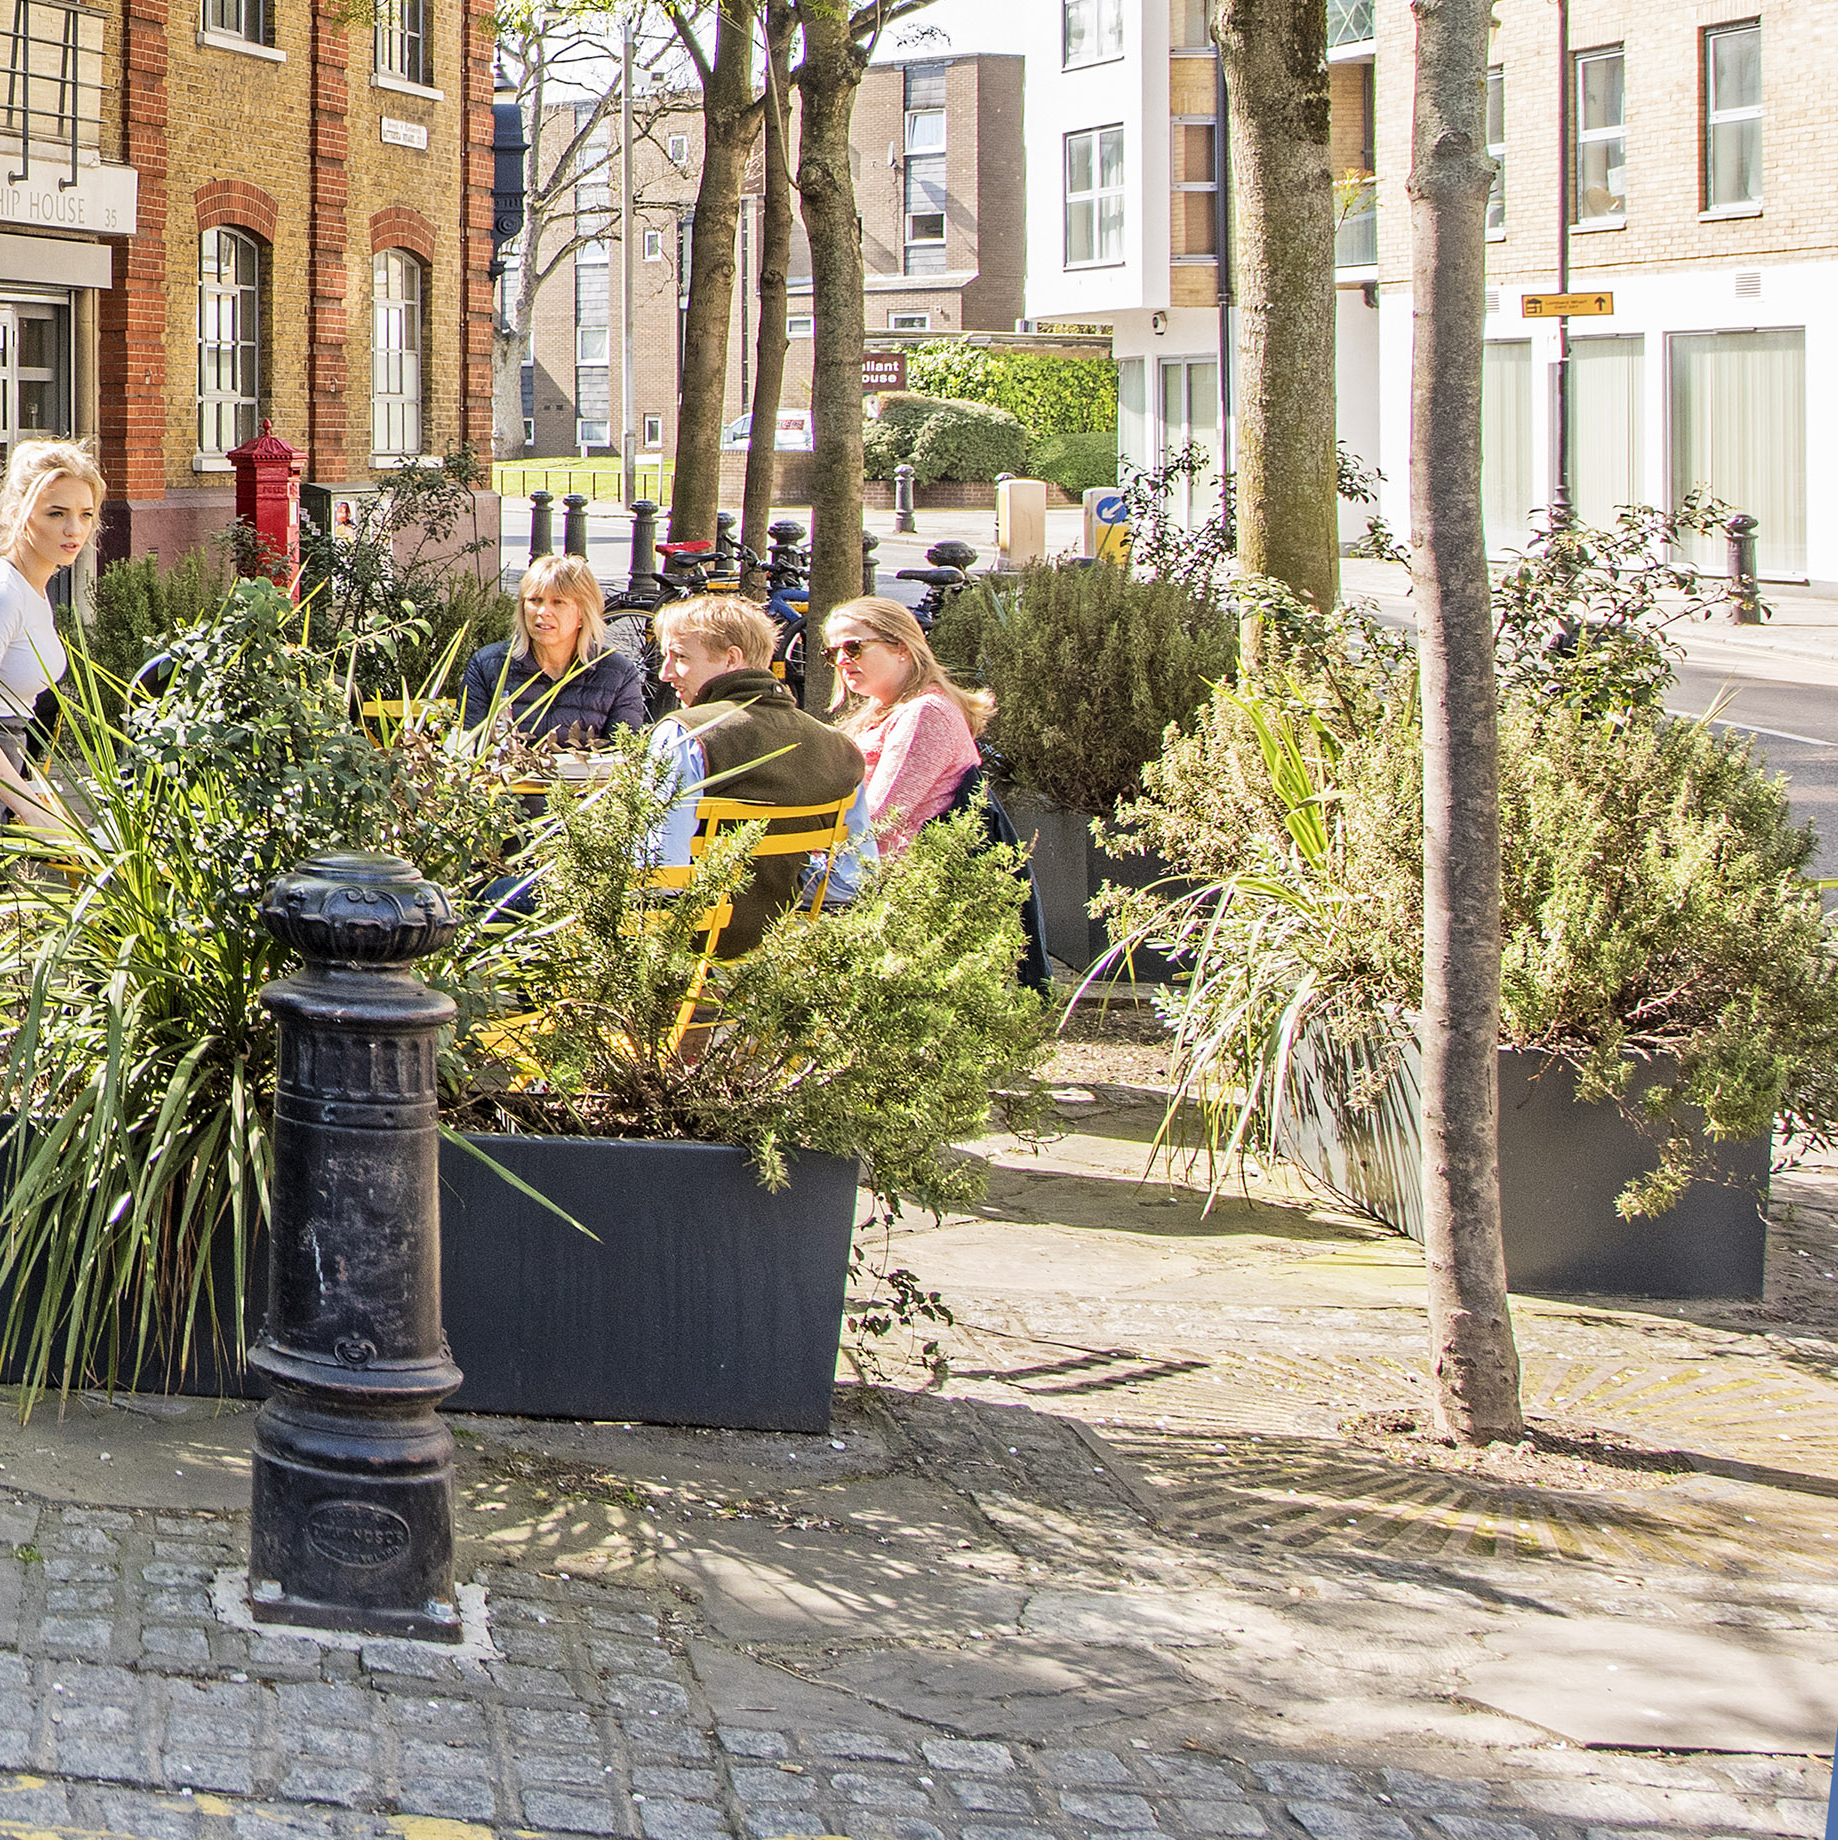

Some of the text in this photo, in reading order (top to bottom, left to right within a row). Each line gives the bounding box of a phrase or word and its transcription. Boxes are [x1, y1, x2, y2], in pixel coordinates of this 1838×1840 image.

[29, 191, 85, 224] HOUSE
[104, 208, 118, 228] 35
[862, 360, 900, 372] liant
[862, 373, 898, 384] ouse
